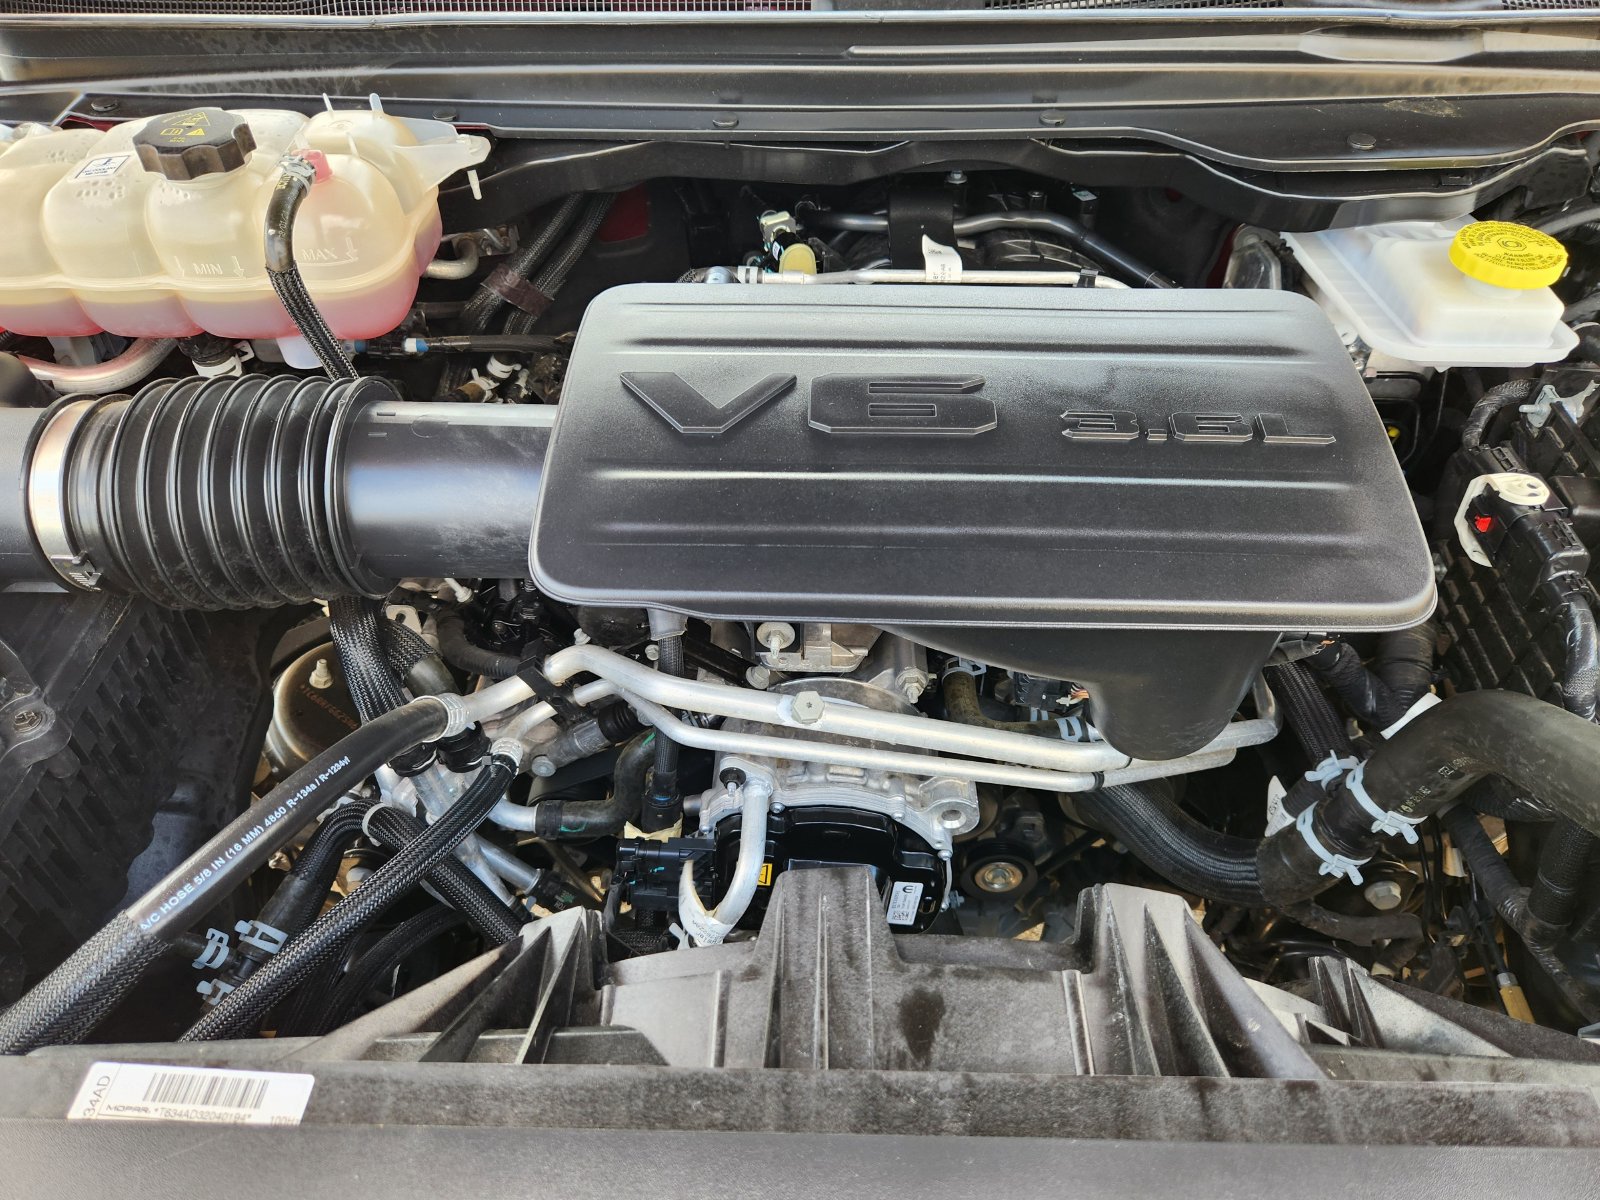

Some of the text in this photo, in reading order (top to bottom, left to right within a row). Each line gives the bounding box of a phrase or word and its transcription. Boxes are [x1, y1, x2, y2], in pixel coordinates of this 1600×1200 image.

[192, 263, 224, 275] MIN
[301, 247, 338, 261] MAX
[620, 371, 1337, 445] V6 3.6L
[139, 912, 160, 931] A/C
[159, 882, 195, 915] HOSE
[193, 868, 213, 886] 5/8
[210, 855, 226, 872] IN
[226, 842, 243, 860] (16
[241, 825, 265, 846] MM)
[264, 806, 287, 828] 4860
[287, 783, 317, 808] R-134a
